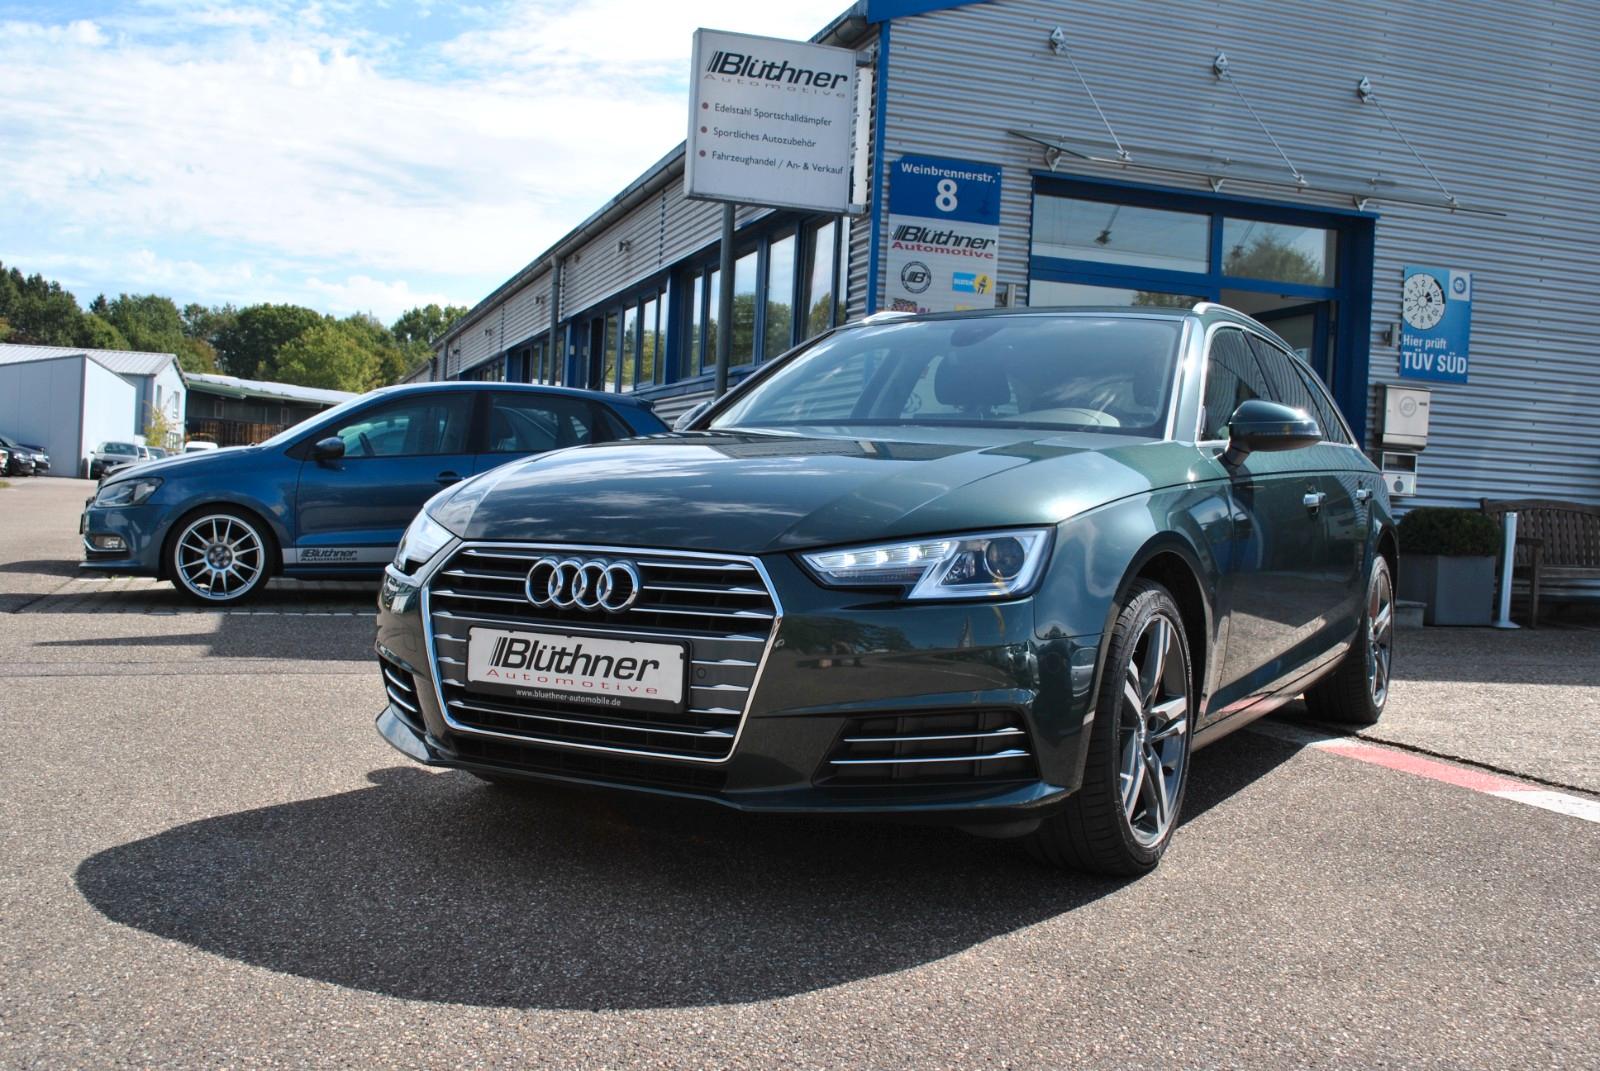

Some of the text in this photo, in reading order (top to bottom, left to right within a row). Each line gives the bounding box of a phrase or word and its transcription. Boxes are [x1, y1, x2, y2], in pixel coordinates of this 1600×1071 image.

[709, 51, 848, 89] Blüthner
[704, 73, 845, 98] Automotive
[714, 102, 832, 127] Edelstahl Sportschalldämpfer
[713, 127, 816, 148] Sportliches Autozubehör
[711, 151, 776, 167] Fahrzeughandel
[812, 164, 844, 174] Verkauf
[901, 162, 996, 183] Weinbrennerstr.
[935, 178, 958, 212] 8
[892, 224, 996, 250] Blüthner
[891, 241, 994, 259] Automotive
[1403, 334, 1447, 350] Hier prüft
[1403, 348, 1467, 374] TÜV SÜD
[490, 636, 660, 682] Blüthner
[486, 668, 658, 695] Automotive
[516, 688, 621, 706] www.bluethner-automobile.de
